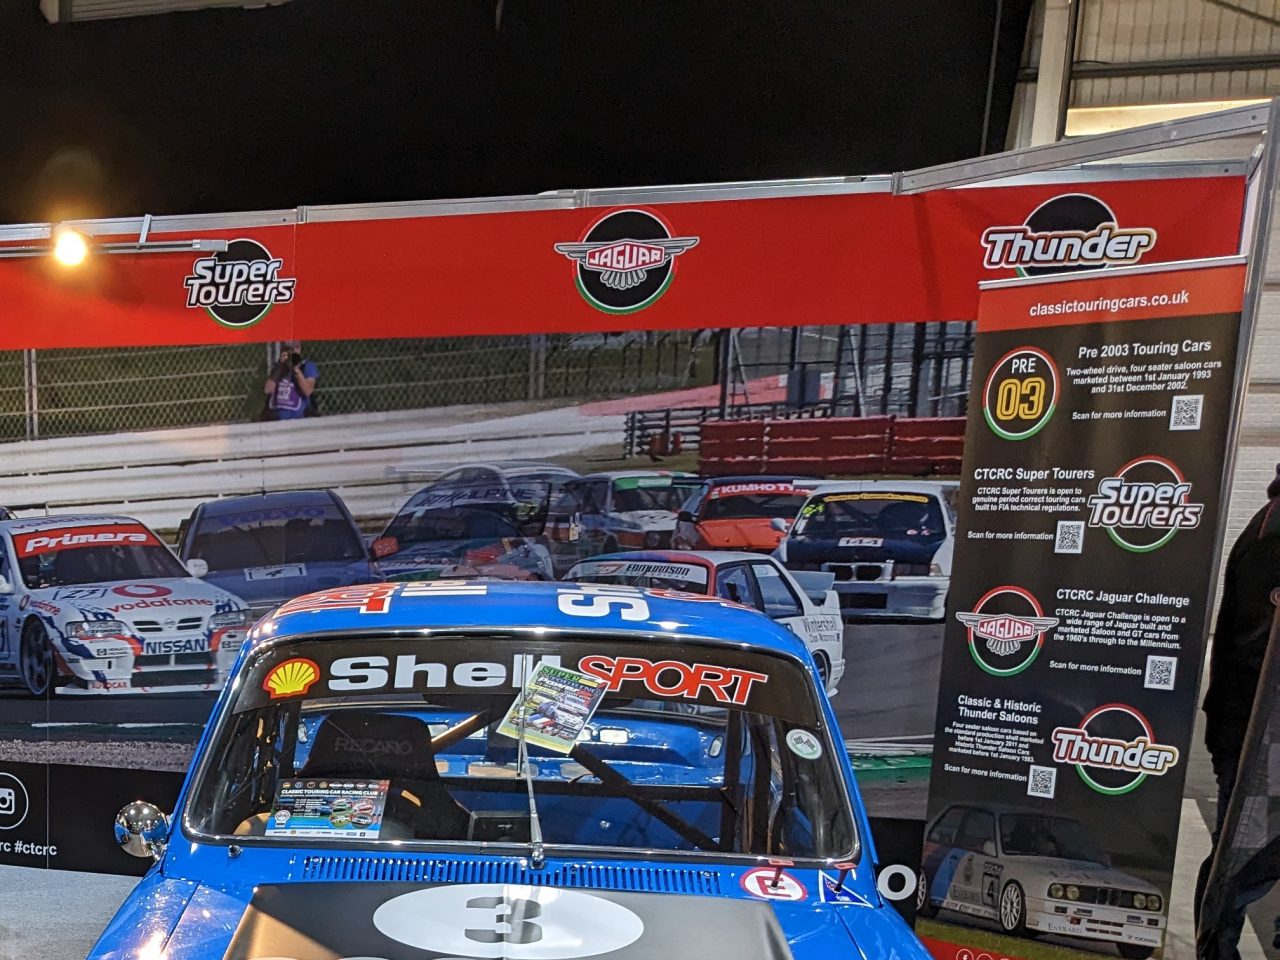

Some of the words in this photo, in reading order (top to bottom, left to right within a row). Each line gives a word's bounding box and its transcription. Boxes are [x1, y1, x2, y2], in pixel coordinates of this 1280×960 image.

[986, 228, 1151, 263] Thunder
[588, 243, 662, 269] JAGUAR
[192, 258, 281, 284] Super
[187, 278, 294, 308] Tourers
[1029, 290, 1189, 317] classictouringcars.co.uk
[1078, 346, 1098, 359] Pre
[1100, 344, 1129, 357] 2003
[1132, 342, 1178, 357] Touring
[1182, 340, 1212, 352] Cars
[1011, 358, 1036, 373] PRE
[1066, 366, 1105, 376] Two-wheel
[1106, 365, 1128, 375] drive,
[1130, 364, 1146, 372] four
[1148, 363, 1172, 371] seater
[1174, 362, 1202, 370] saloon
[1073, 375, 1108, 385] marketed
[1110, 373, 1142, 383] between
[1144, 373, 1156, 381] 1st
[1157, 372, 1190, 382] January
[1192, 370, 1211, 378] 1993
[1091, 385, 1106, 393] and
[1108, 384, 1124, 393] 31st
[1125, 382, 1165, 392] December
[1167, 381, 1188, 390] 2002.
[996, 377, 1046, 421] 03
[1072, 411, 1089, 420] Scan
[1091, 410, 1101, 419] for
[1103, 411, 1122, 419] more
[1124, 409, 1167, 418] information
[974, 468, 1013, 479] CTCRC
[1016, 468, 1048, 482] Super
[1052, 467, 1095, 479] Tourers
[722, 483, 775, 493] KUMHO
[977, 487, 1001, 495] CTCRC
[1002, 487, 1021, 496] Super
[1057, 488, 1073, 496] open
[1100, 479, 1189, 506] Super
[972, 496, 997, 504] genuine
[998, 496, 1019, 504] period
[1046, 496, 1069, 504] touring
[1041, 505, 1081, 513] regulations.
[1091, 498, 1202, 527] Tourers
[25, 532, 148, 553] Primera
[967, 531, 984, 539] Scan
[985, 531, 995, 539] for
[1014, 532, 1054, 540] information
[107, 597, 214, 613] vodafone
[1056, 588, 1094, 601] CTCRC
[1096, 591, 1133, 604] Jaguar
[1135, 592, 1190, 606] Challenge
[1055, 608, 1080, 617] CTCRC
[1081, 610, 1106, 619] Jaguar
[1107, 611, 1142, 621] Challenge
[1151, 615, 1170, 623] open
[1083, 619, 1104, 627] range
[1114, 620, 1138, 630] Jaguar
[1140, 622, 1156, 630] built
[979, 616, 1032, 639] JAGUAR
[1057, 626, 1089, 634] marketed
[1091, 627, 1115, 635] Saloon
[145, 638, 206, 655] NISSAN
[1089, 636, 1116, 645] through
[1127, 638, 1139, 646] the
[1140, 639, 1181, 649] Millennium.
[1049, 661, 1067, 669] Scan
[1068, 661, 1079, 670] for
[1100, 664, 1142, 675] information
[328, 654, 561, 691] Shel
[579, 656, 768, 706] SPORT
[958, 694, 992, 708] Classic
[994, 698, 1002, 708] &
[1004, 699, 1042, 713] Historic
[959, 706, 997, 721] Thunder
[999, 711, 1039, 725] Saloons
[334, 737, 414, 755] RECARO
[1054, 732, 1175, 770] Thunder
[944, 763, 960, 772] Scan
[971, 768, 988, 777] more
[989, 769, 1027, 781] information
[14, 840, 57, 855] #ctcrc
[755, 875, 792, 898] E
[463, 897, 544, 944] 3
